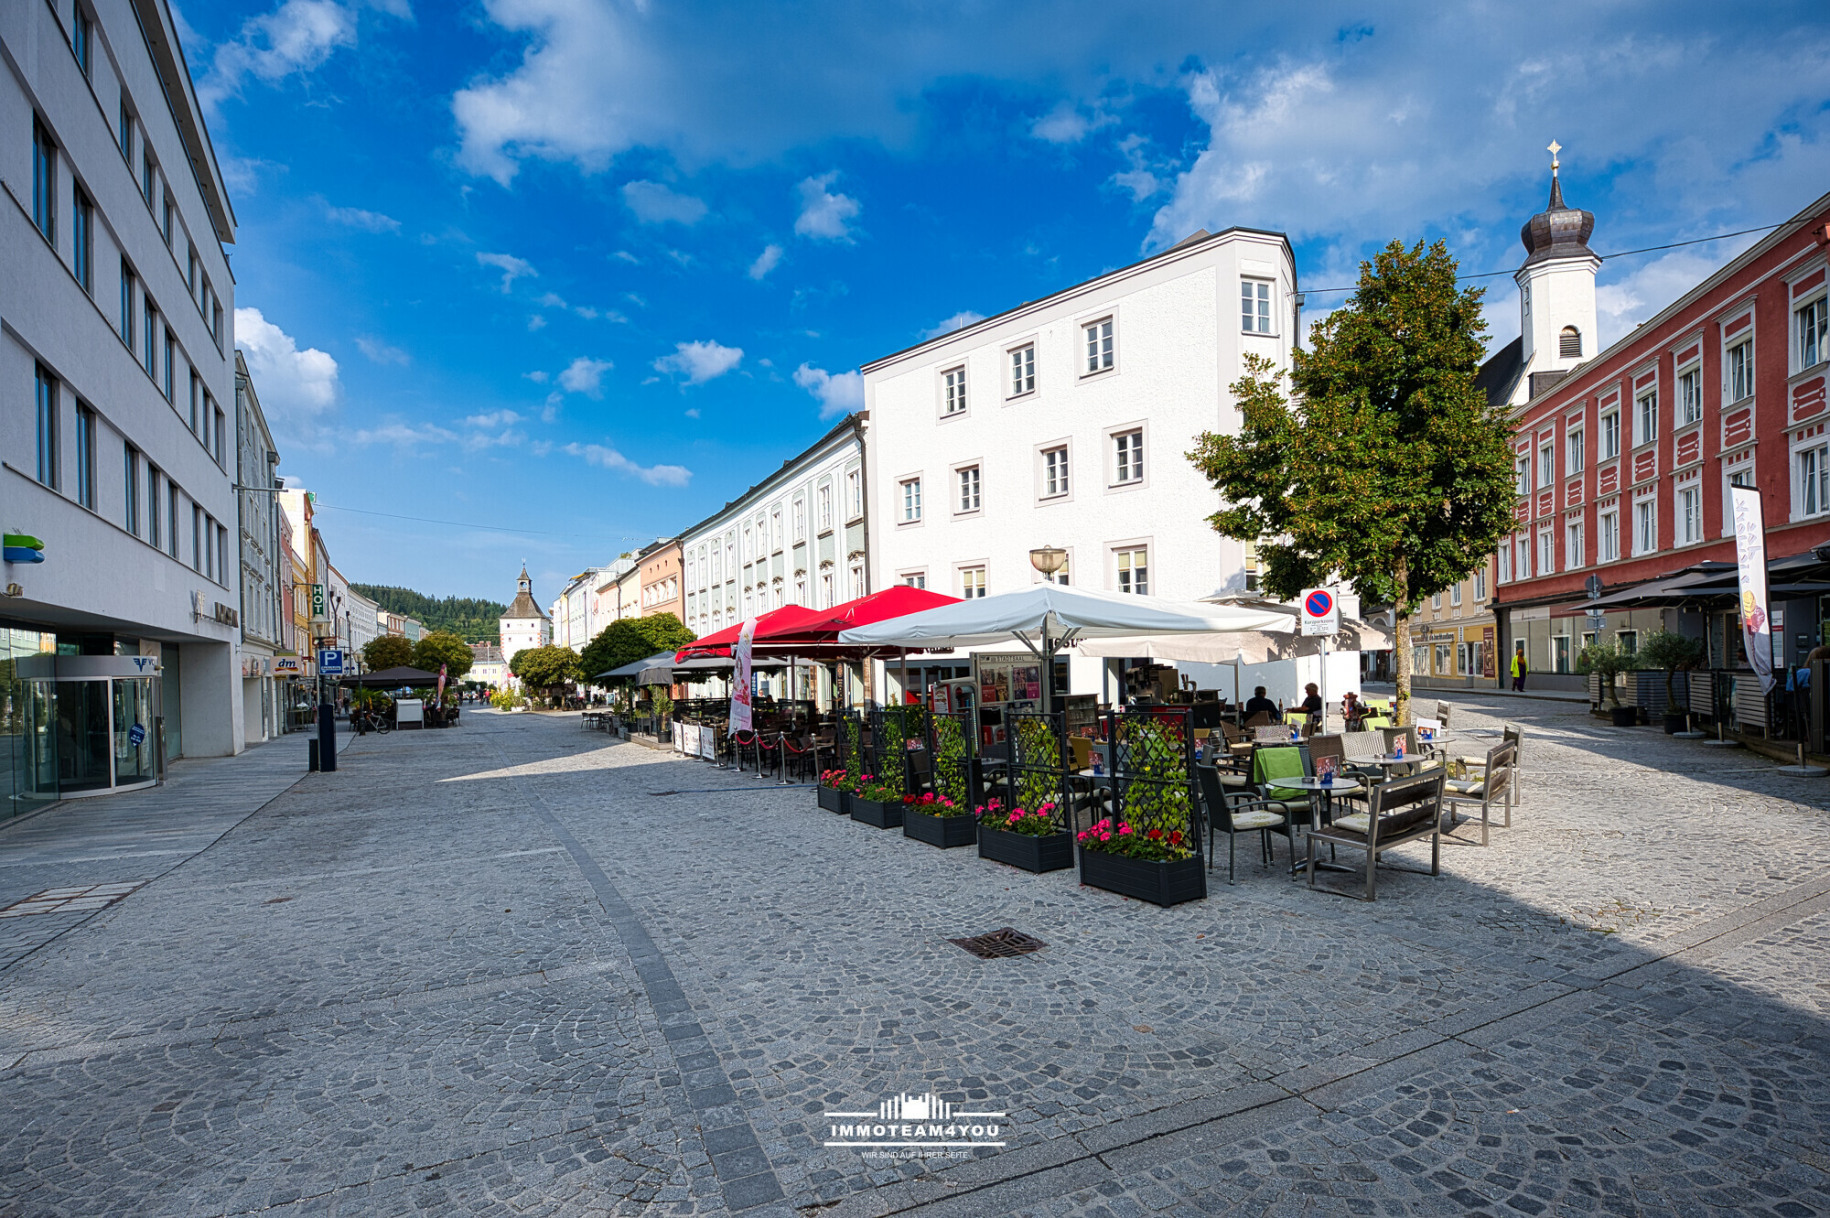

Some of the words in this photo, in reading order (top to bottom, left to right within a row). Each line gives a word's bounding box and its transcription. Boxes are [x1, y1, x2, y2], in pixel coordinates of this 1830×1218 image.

[313, 586, 323, 613] HOT
[278, 658, 296, 668] dm
[324, 652, 337, 665] P
